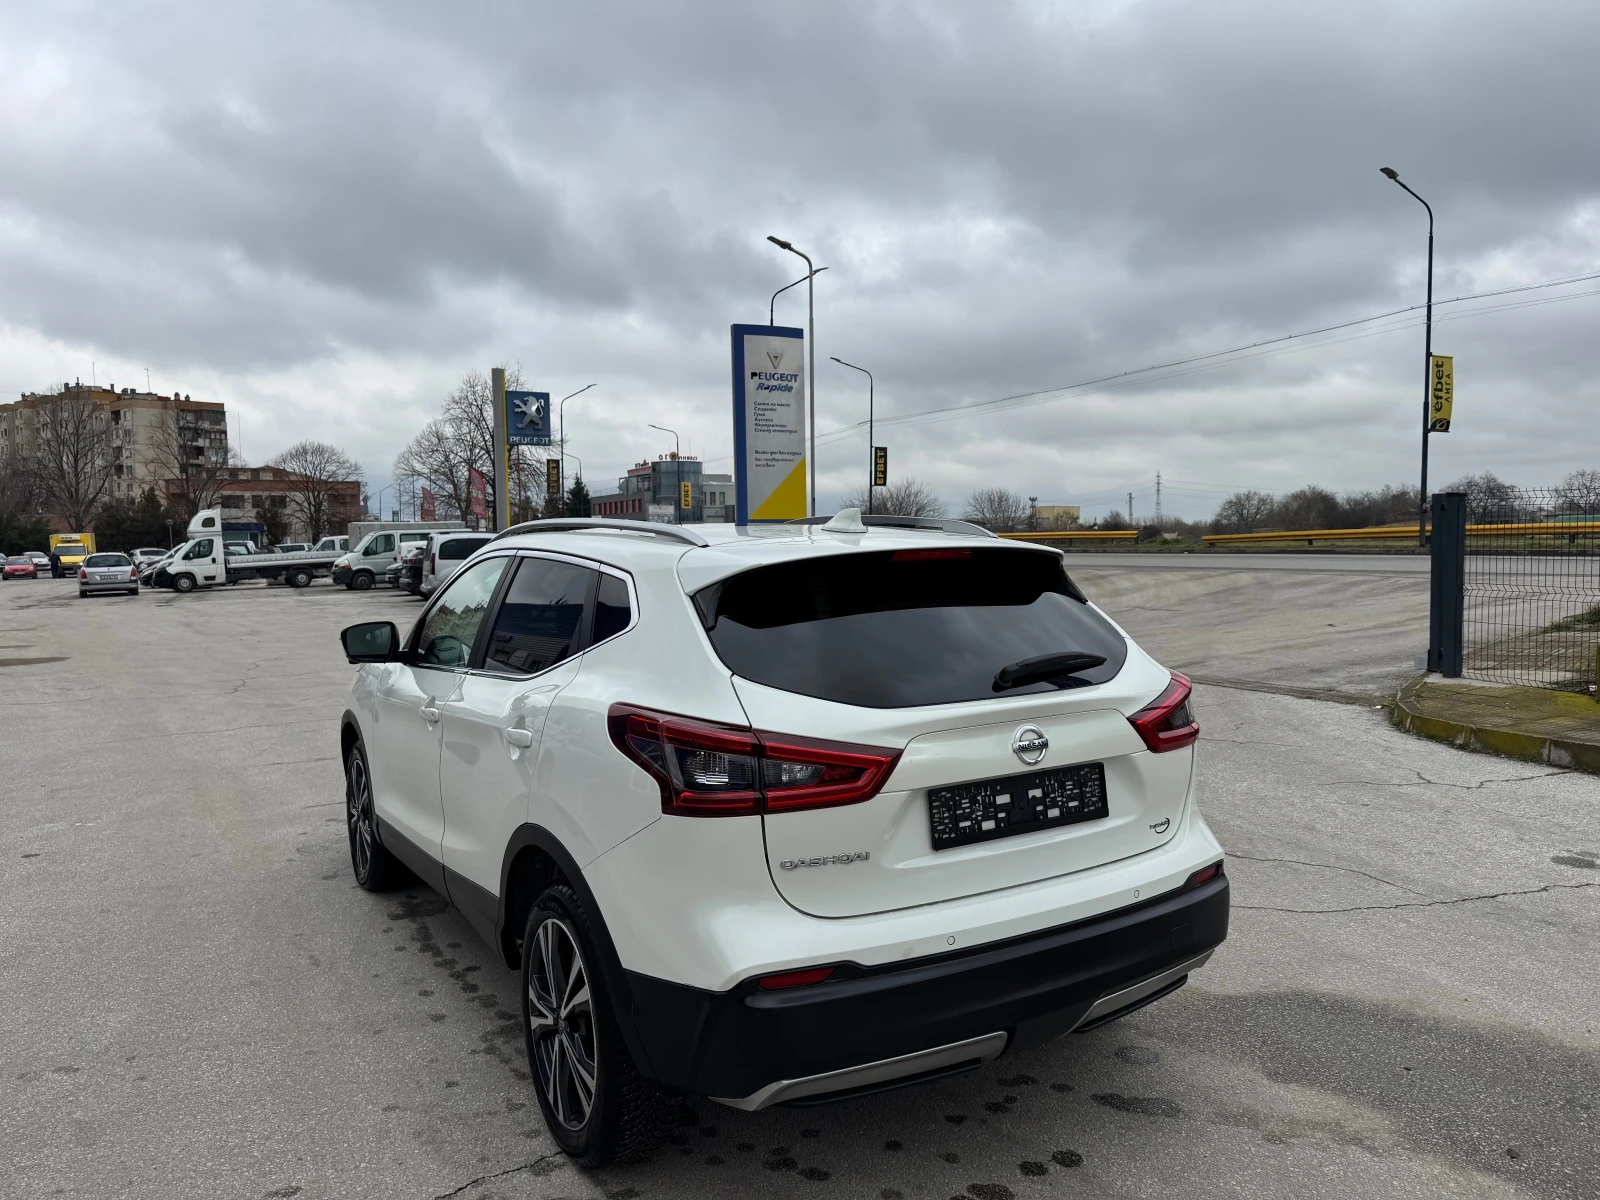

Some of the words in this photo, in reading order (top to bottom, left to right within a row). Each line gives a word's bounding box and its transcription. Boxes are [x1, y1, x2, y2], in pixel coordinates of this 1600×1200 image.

[750, 371, 799, 383] PEUGEOT
[756, 382, 794, 393] Rapide
[1433, 360, 1444, 413] efbet
[510, 436, 550, 445] PEUGEOT
[877, 449, 885, 485] EFBET
[1018, 740, 1047, 751] NISSAN
[780, 851, 870, 871] QASHQAI
